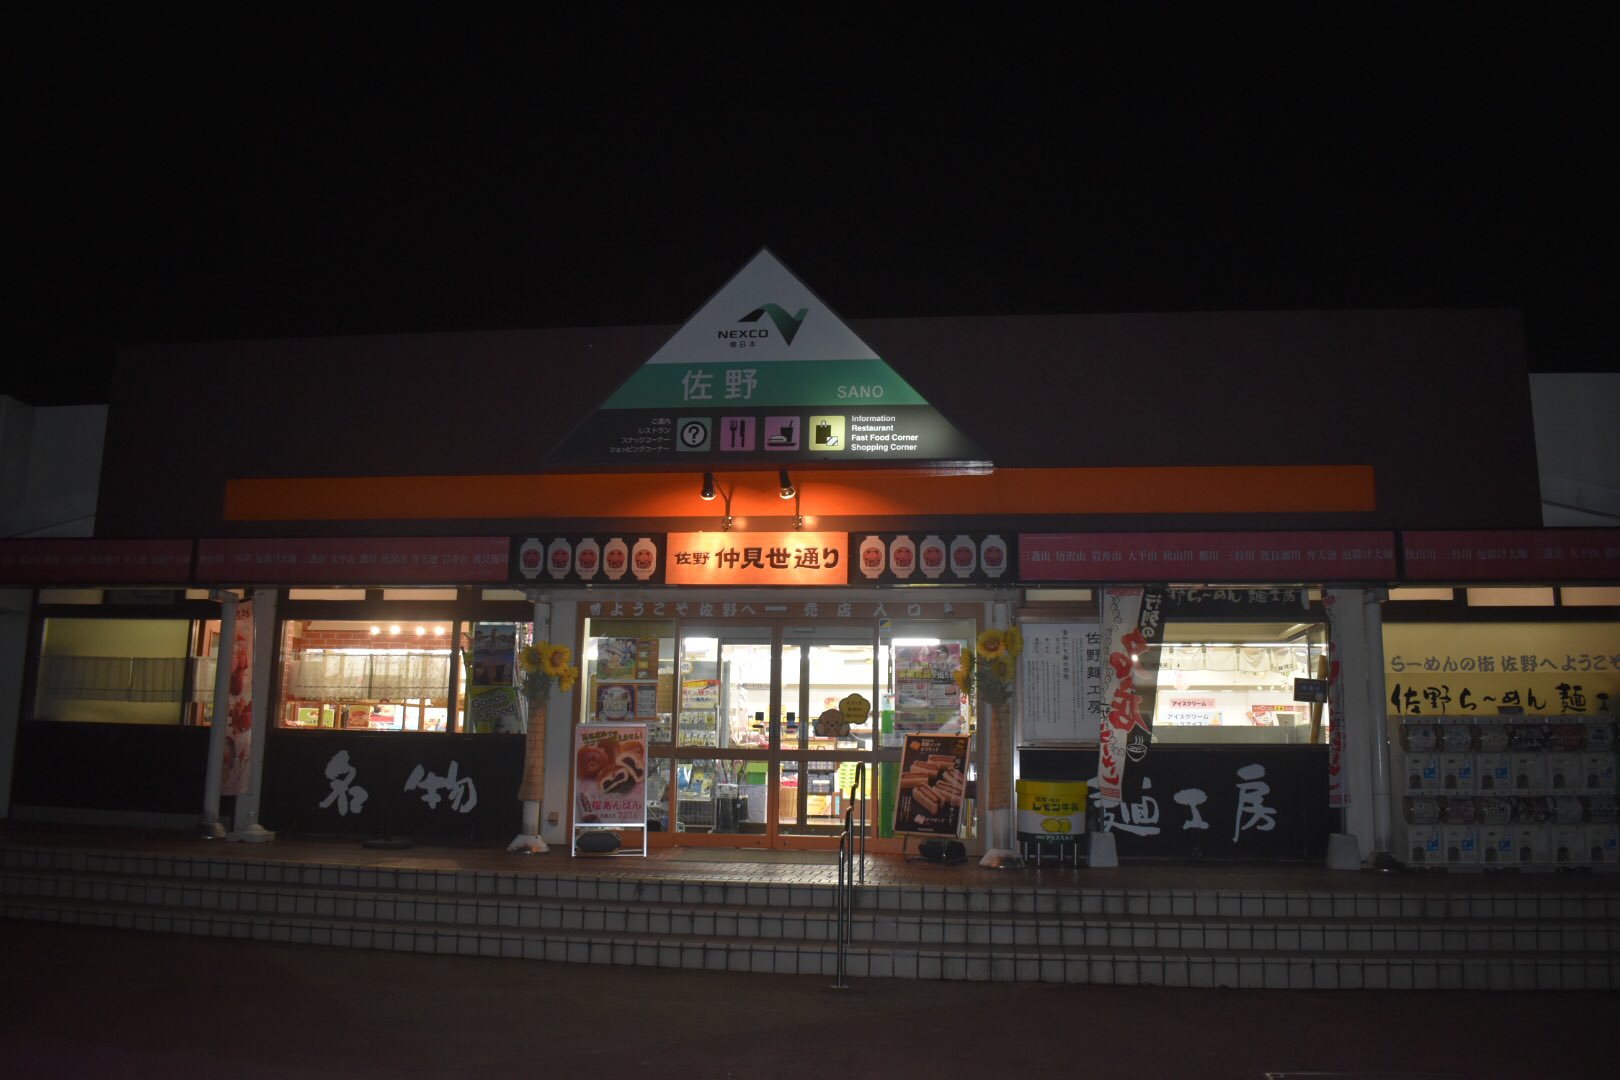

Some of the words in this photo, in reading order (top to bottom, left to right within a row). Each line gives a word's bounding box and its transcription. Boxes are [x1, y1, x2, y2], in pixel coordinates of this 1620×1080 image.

[718, 330, 768, 338] NEXCO
[682, 369, 758, 400] 佐野
[837, 385, 884, 398] SANO
[851, 424, 894, 432] Restaurant
[891, 433, 919, 441] Corner
[851, 443, 889, 452] Shopping
[890, 443, 917, 451] Corner
[674, 551, 710, 566] 佐野
[715, 547, 839, 569] 仲見世通り
[472, 692, 509, 709] Goods
[486, 703, 516, 719] Food
[319, 750, 478, 816] 名物
